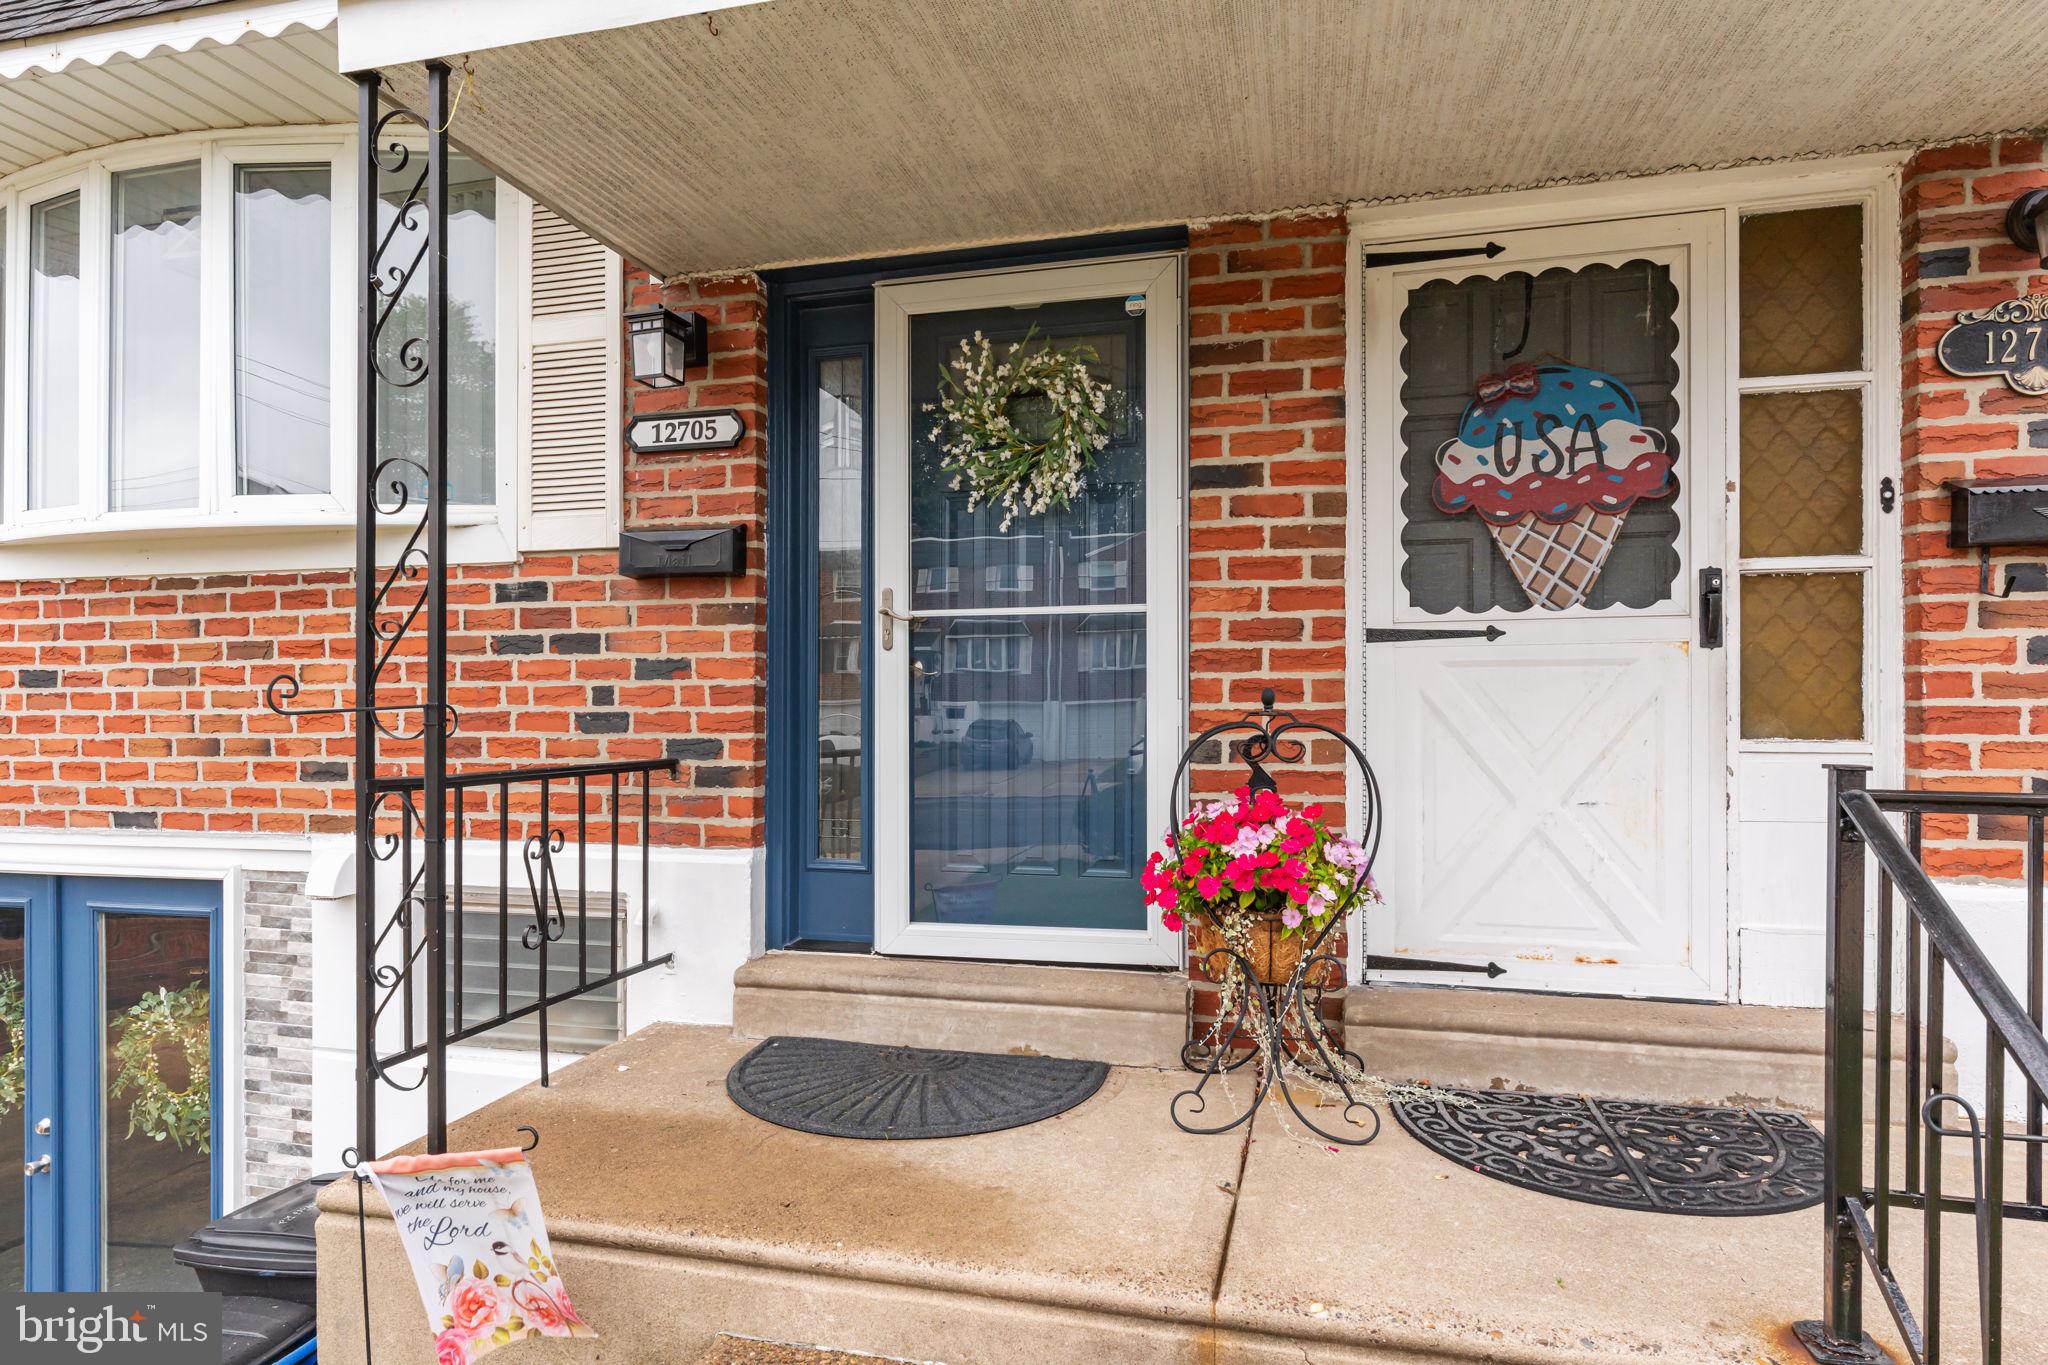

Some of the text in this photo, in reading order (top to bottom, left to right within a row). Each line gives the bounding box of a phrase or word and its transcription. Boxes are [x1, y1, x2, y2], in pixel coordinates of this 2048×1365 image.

[1985, 327, 2042, 364] 127
[651, 418, 718, 444] 12705
[1493, 413, 1609, 477] USA
[404, 1182, 440, 1198] and
[442, 1185, 465, 1196] my
[449, 1177, 470, 1185] for
[395, 1198, 488, 1219] we will serve
[407, 1215, 492, 1251] the Lord
